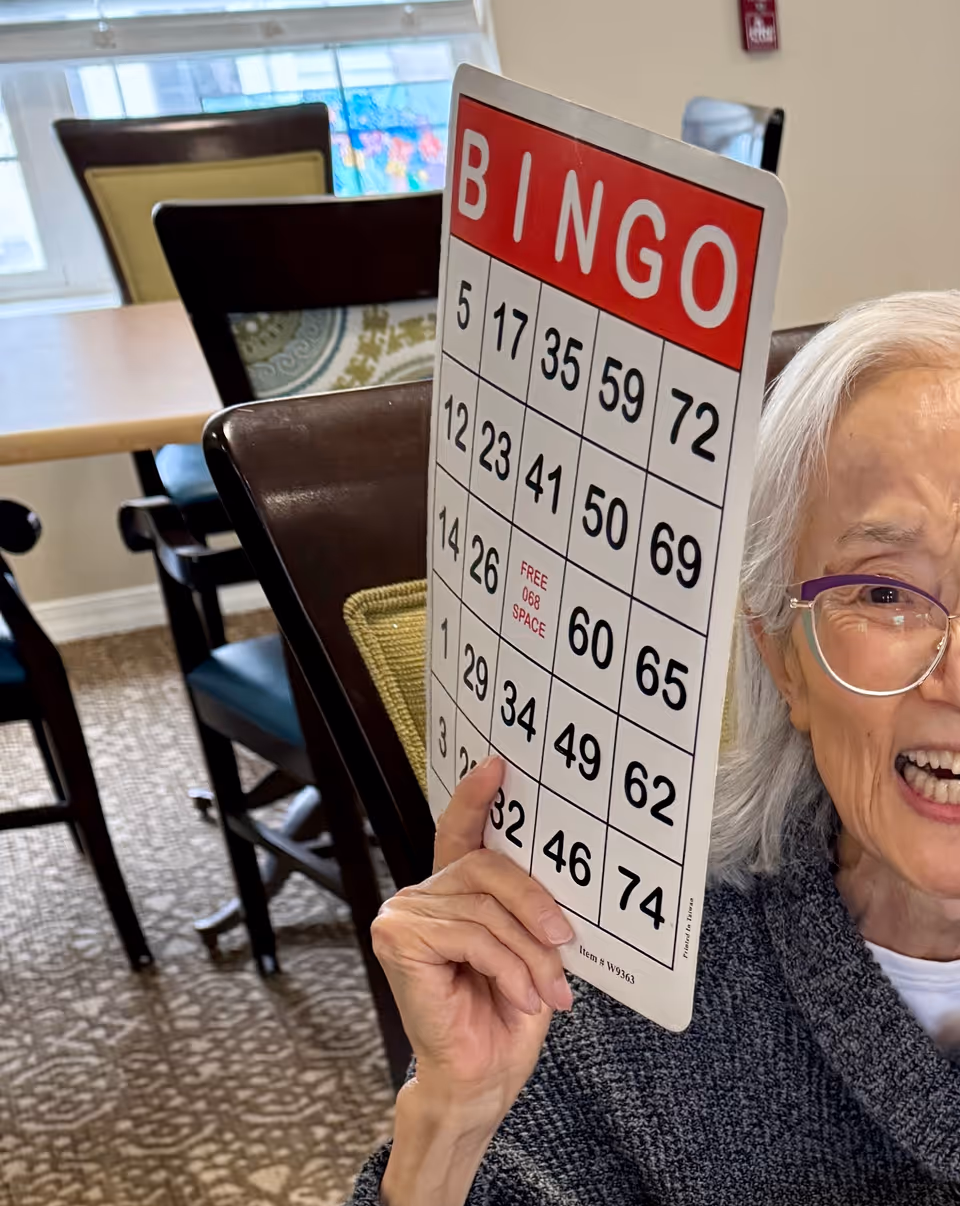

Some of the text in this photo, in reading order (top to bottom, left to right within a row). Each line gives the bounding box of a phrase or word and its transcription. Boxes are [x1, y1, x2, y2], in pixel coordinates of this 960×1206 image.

[459, 129, 737, 328] BINGO
[457, 280, 719, 462] 5 17 35 59 72
[445, 395, 701, 589] 12 23 41 50 69
[521, 561, 547, 590] FREE
[439, 507, 688, 711] 14 26 60 65
[513, 605, 545, 637] SPACE
[523, 587, 540, 609] 068
[441, 619, 676, 826] 1 29 34 49 62
[439, 716, 665, 930] 3 2 32 46 74
[580, 945, 597, 963] Item
[607, 961, 634, 984] W9363
